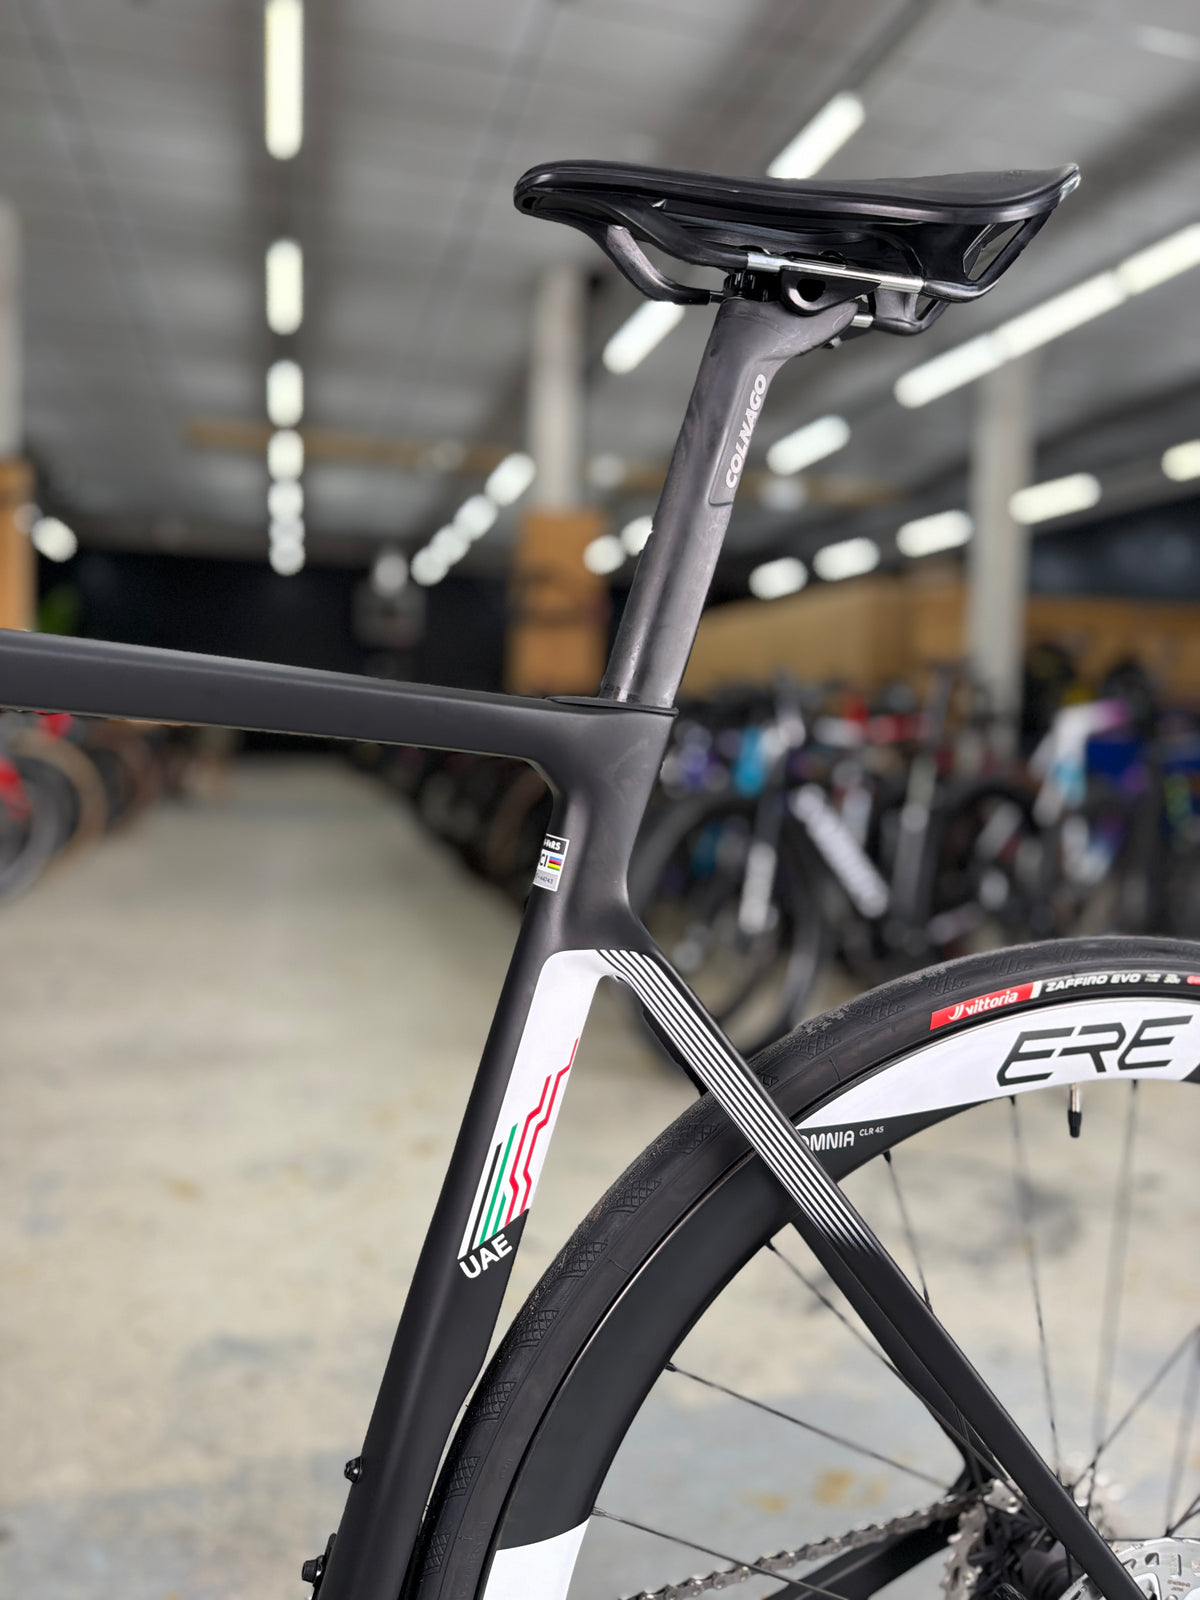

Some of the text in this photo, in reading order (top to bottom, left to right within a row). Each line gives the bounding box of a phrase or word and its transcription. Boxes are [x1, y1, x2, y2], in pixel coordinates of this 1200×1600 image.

[725, 373, 767, 489] COLNAGO
[1045, 974, 1108, 993] ZAFFIRO
[1110, 972, 1142, 984] EVO
[964, 990, 1019, 1016] vittoria
[996, 1014, 1194, 1088] ERE
[859, 1127, 874, 1137] CLR
[459, 1232, 513, 1279] UAE
